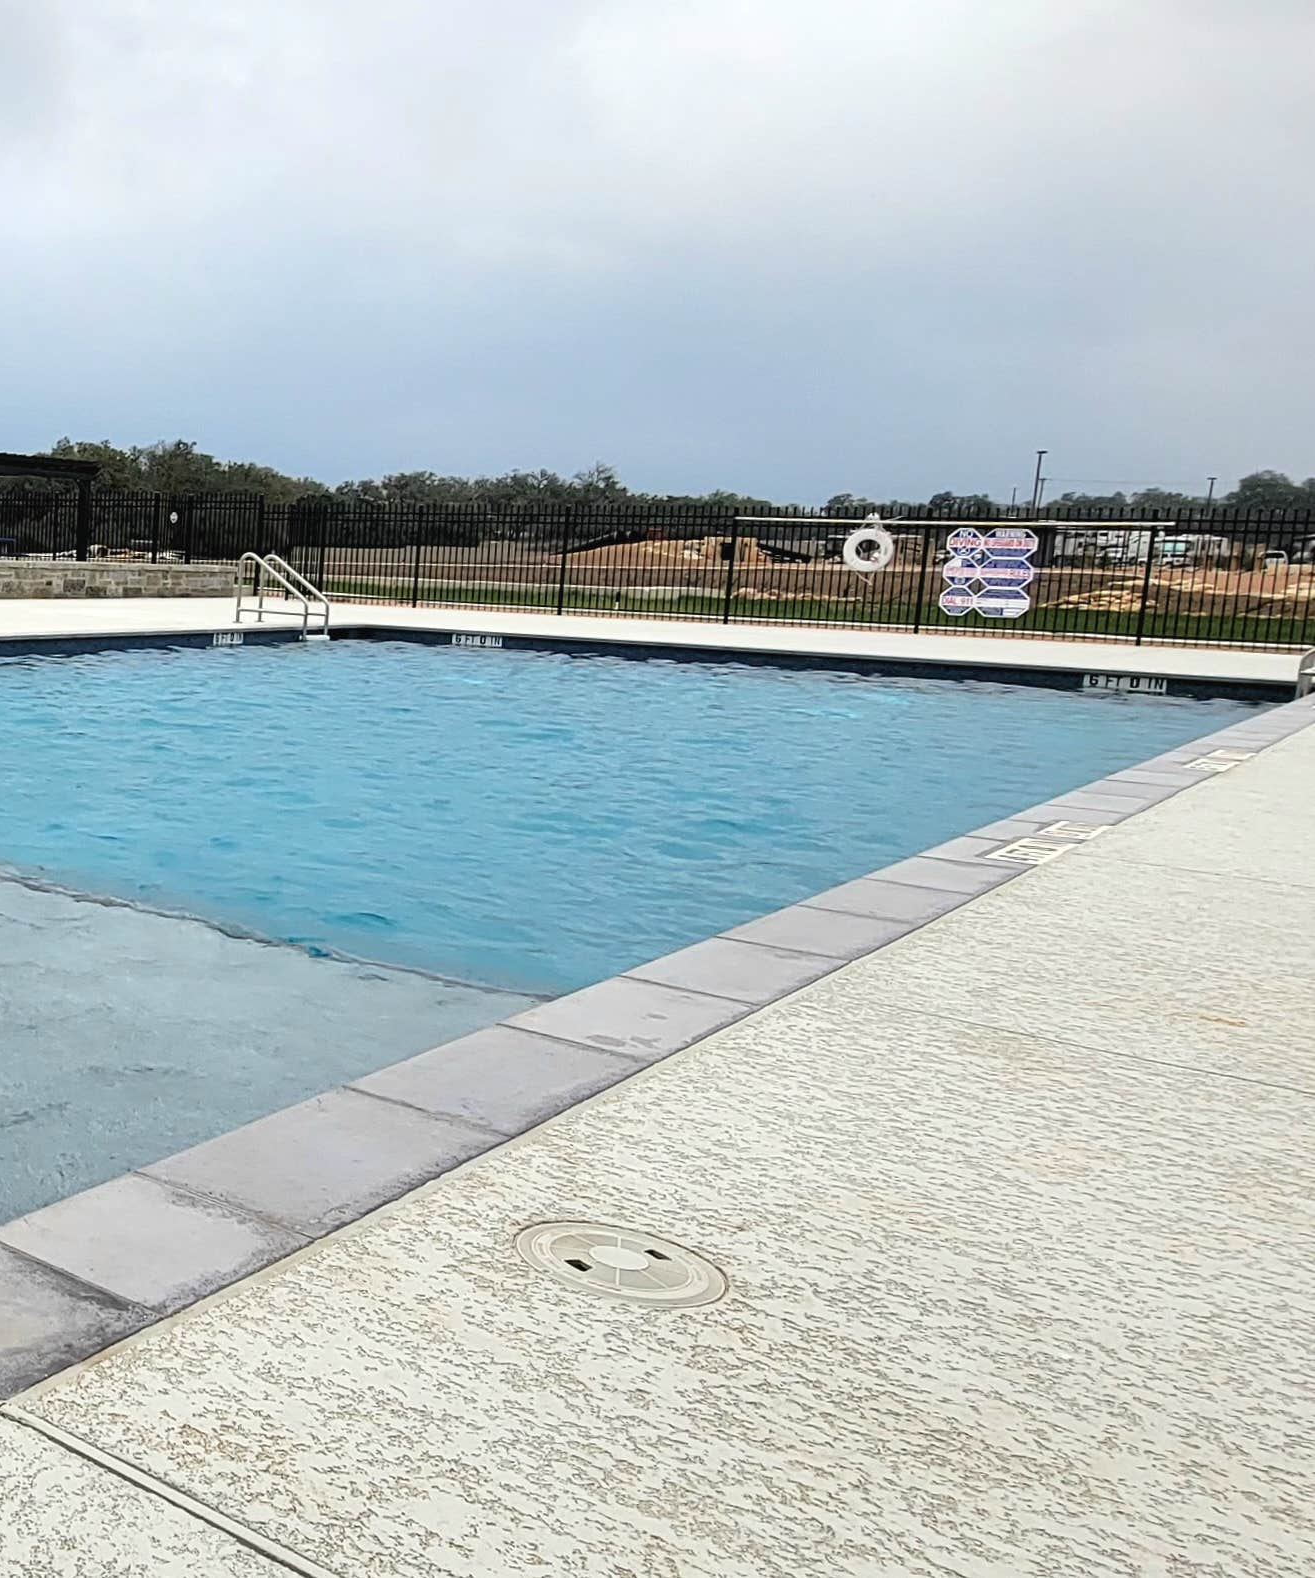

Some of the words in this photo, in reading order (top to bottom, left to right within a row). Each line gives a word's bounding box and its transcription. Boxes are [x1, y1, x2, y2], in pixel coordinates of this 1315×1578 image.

[959, 529, 973, 538] NO
[949, 538, 981, 548] DIVING
[961, 596, 973, 605] 911
[455, 634, 462, 643] 6
[465, 634, 475, 644] FT
[479, 635, 486, 645] 0
[490, 635, 500, 645] IN
[1089, 672, 1099, 686] 6
[1105, 674, 1121, 688] FT
[1129, 676, 1140, 689] 0
[1147, 677, 1164, 690] IN
